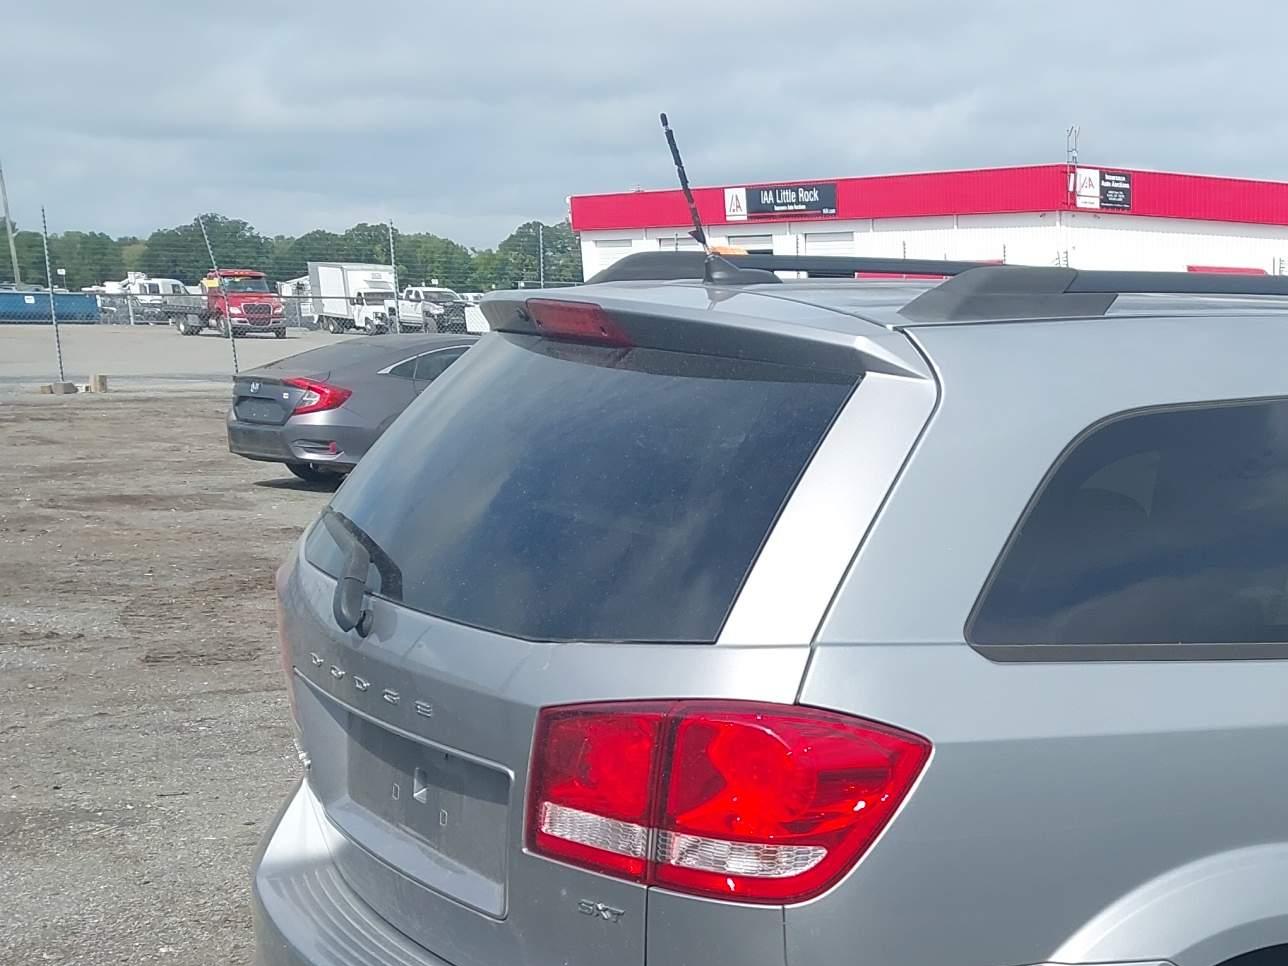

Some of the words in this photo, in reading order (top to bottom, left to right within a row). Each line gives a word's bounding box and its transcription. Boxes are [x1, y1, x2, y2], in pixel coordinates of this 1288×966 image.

[760, 190, 774, 203] IAA
[776, 189, 796, 204] Little
[798, 187, 819, 202] Rock
[310, 651, 432, 718] DODGE
[577, 898, 625, 923] SXT
